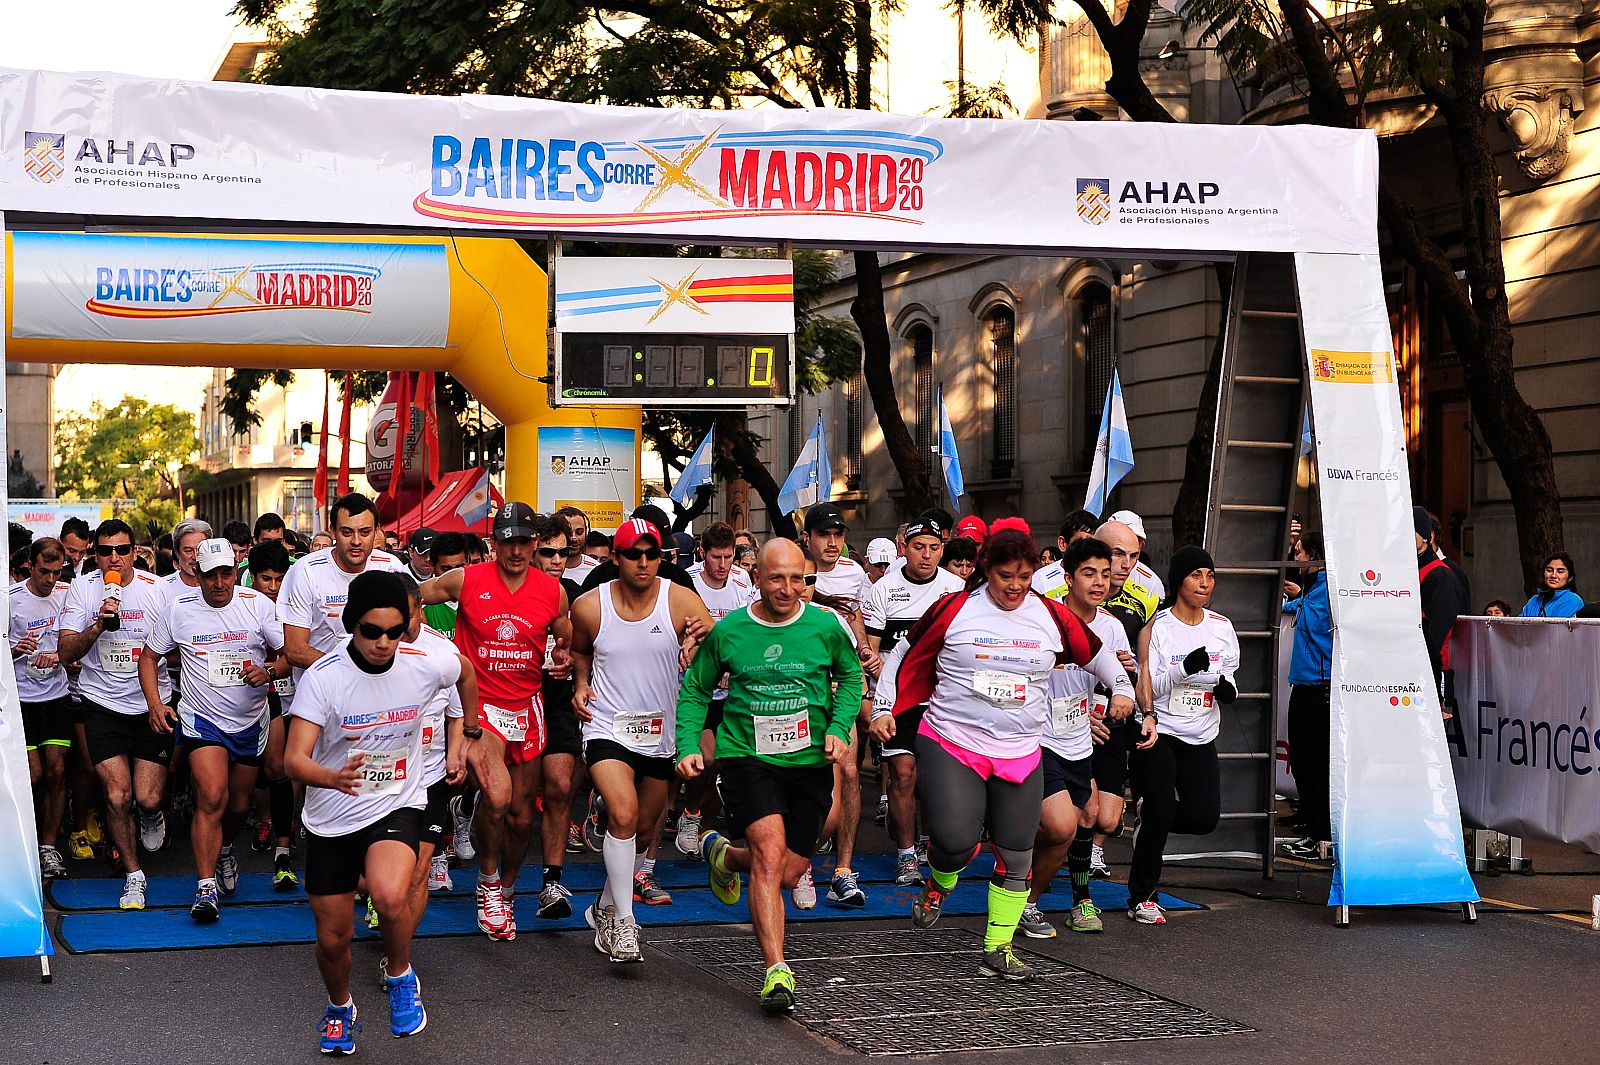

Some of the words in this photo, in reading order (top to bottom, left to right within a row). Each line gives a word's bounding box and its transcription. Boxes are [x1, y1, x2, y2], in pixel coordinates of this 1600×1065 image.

[74, 138, 195, 168] AHAP
[74, 165, 143, 177] Asociación
[147, 169, 198, 181] Hispano
[202, 173, 262, 184] Argentina
[431, 135, 605, 203] BAIRES
[604, 163, 655, 186] CORRE
[899, 157, 923, 184] 20
[74, 176, 90, 184] de
[94, 178, 181, 190] Profesionales
[718, 147, 898, 212] MADRID
[899, 185, 923, 211] 20
[1119, 181, 1220, 204] AHAP
[1119, 206, 1177, 215] Asociación
[1180, 207, 1224, 216] Hispano
[1227, 207, 1279, 216] Argentina
[1119, 216, 1133, 224] de
[1137, 216, 1210, 225] Profesionales
[96, 267, 192, 302] BAIRES
[191, 280, 221, 293] CORRE
[256, 272, 358, 306] MADRID
[569, 456, 611, 467] AHAP
[1327, 468, 1353, 480] BBVA
[1355, 469, 1399, 481] Francés
[109, 654, 130, 663] 1305
[219, 667, 240, 676] 1722
[773, 662, 806, 671] Caminos
[986, 687, 1012, 698] 1724
[1182, 695, 1202, 706] 1330
[343, 713, 370, 725] BAIRES
[387, 708, 414, 723] MADRID
[769, 731, 796, 742] 1732
[362, 770, 392, 781] 1202
